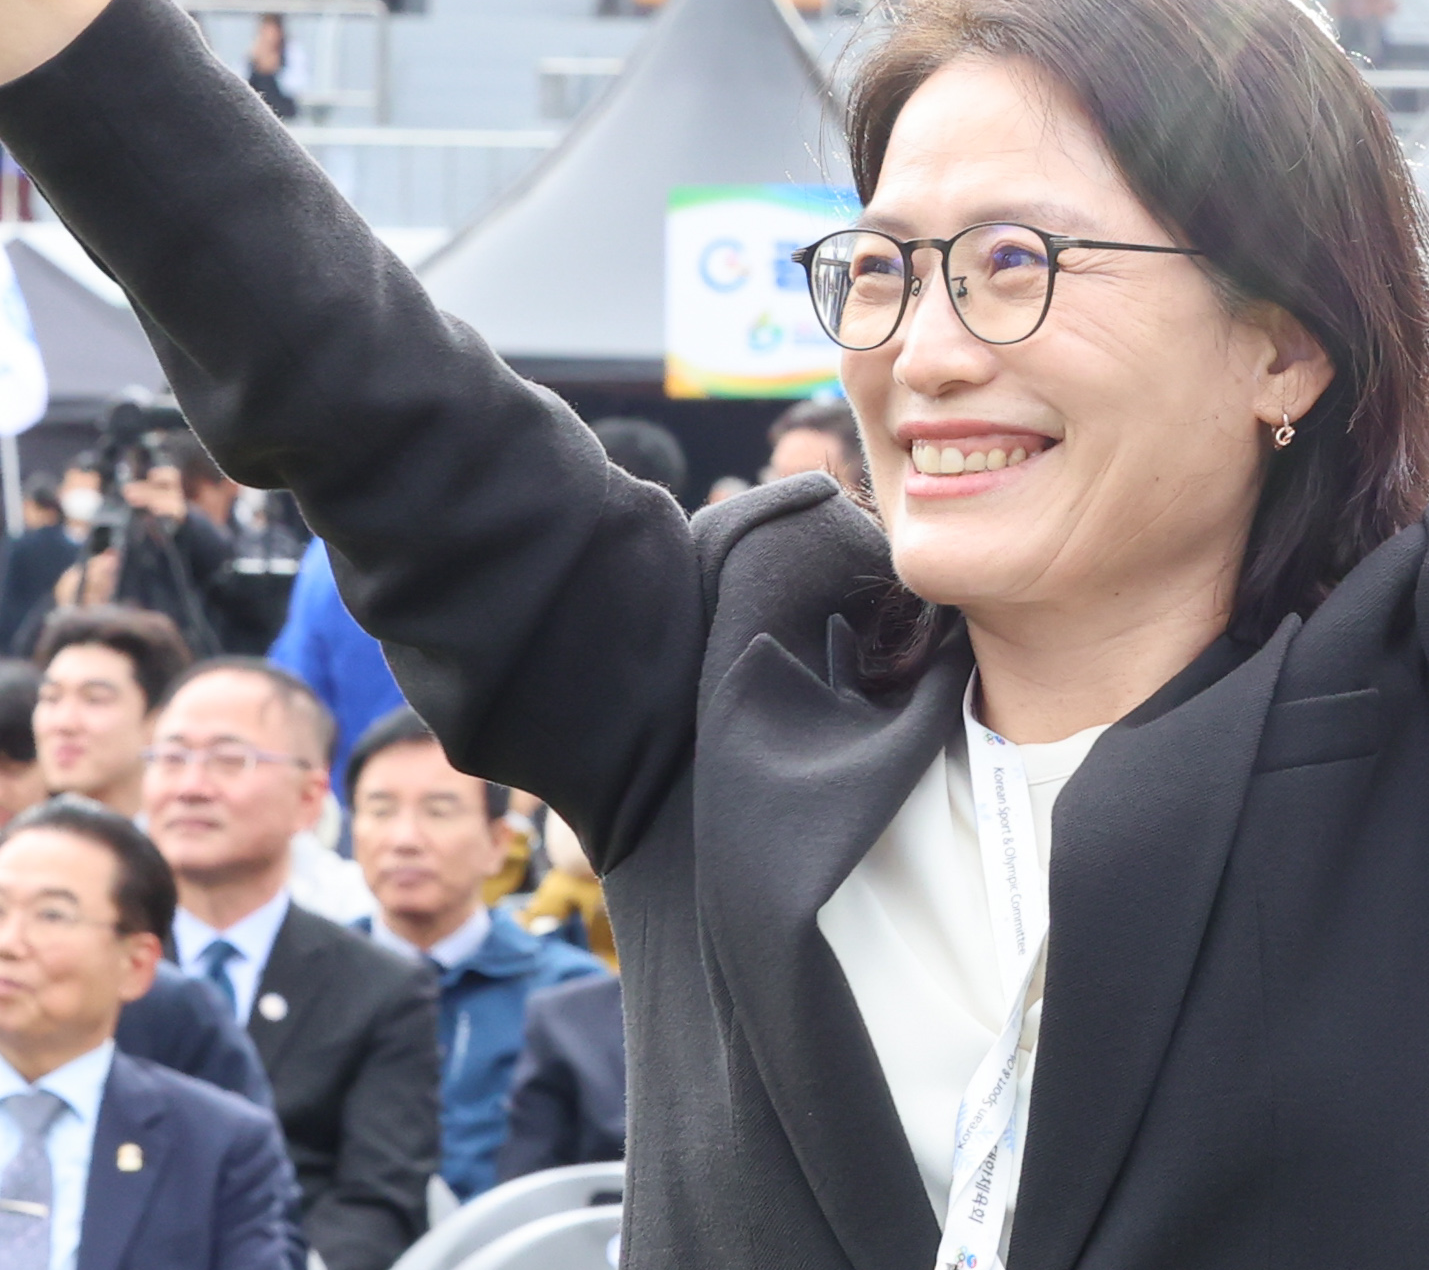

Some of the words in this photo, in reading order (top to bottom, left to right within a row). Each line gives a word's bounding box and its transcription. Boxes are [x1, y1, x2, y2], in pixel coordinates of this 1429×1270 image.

[993, 766, 1007, 805] Korean
[998, 806, 1012, 834] Sport
[1003, 837, 1015, 846] &
[1003, 846, 1018, 893] Olympic
[1010, 893, 1027, 956] Committee
[957, 1107, 988, 1150] Korean
[982, 1076, 1007, 1108] Sport
